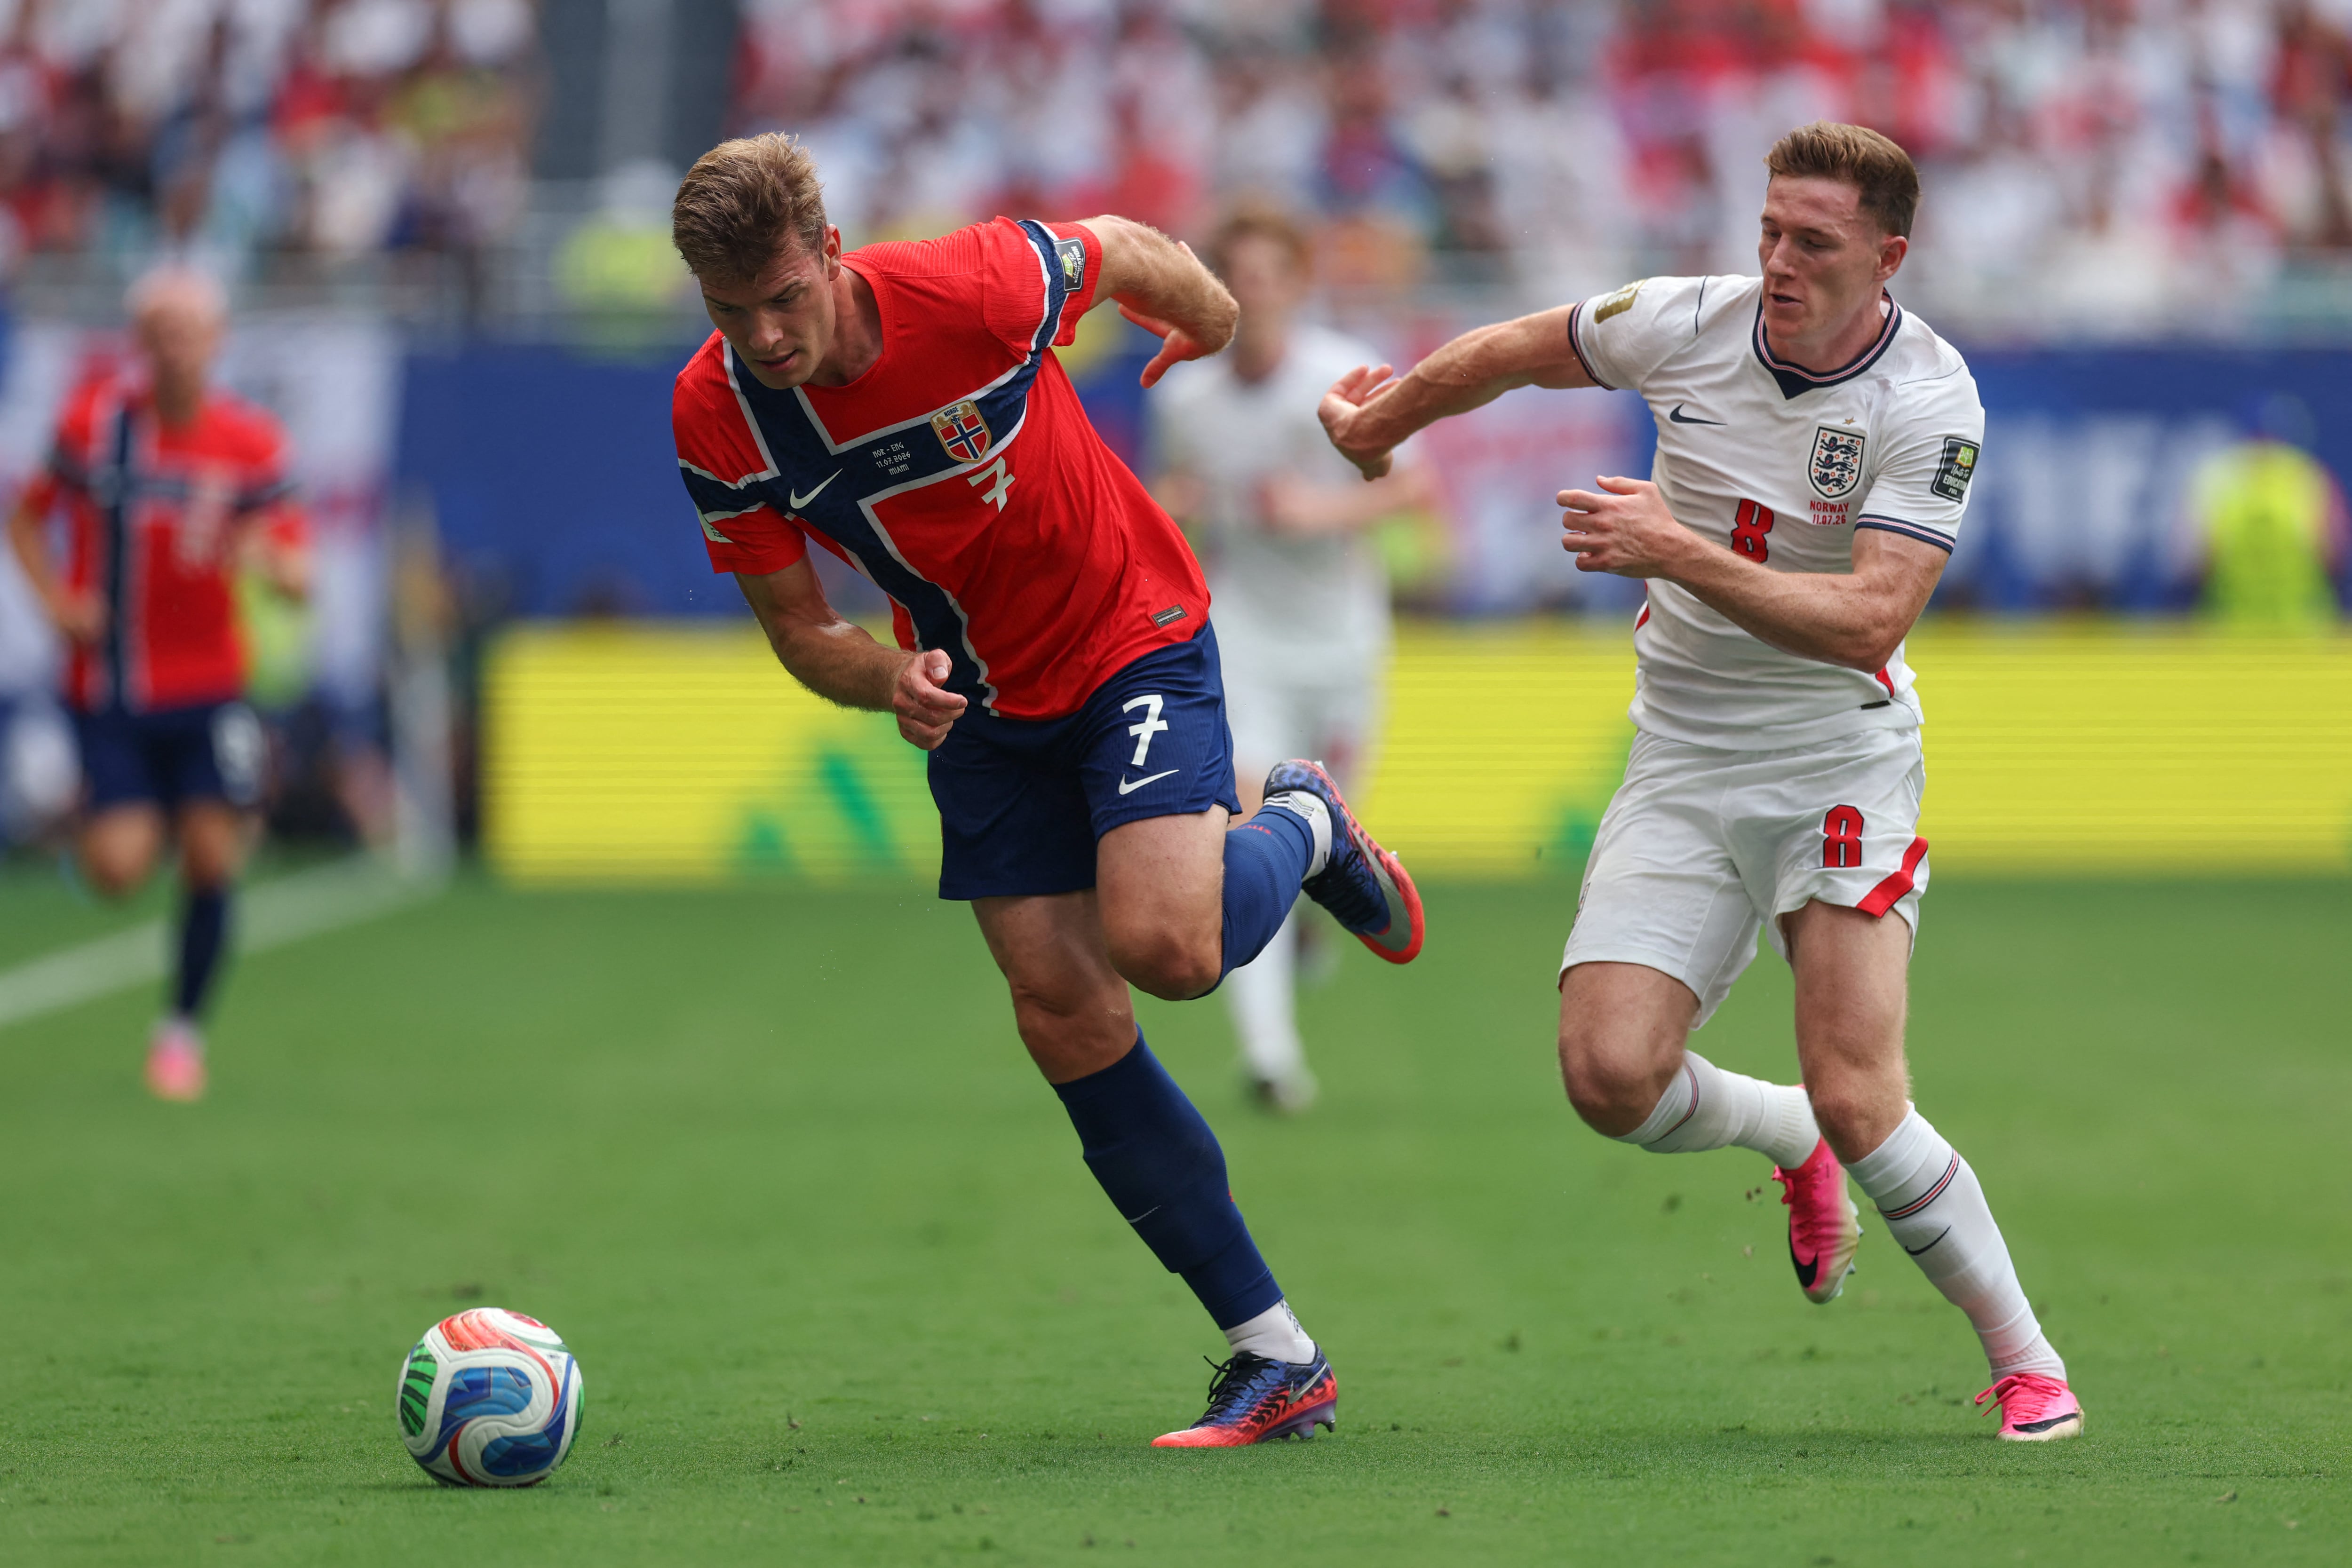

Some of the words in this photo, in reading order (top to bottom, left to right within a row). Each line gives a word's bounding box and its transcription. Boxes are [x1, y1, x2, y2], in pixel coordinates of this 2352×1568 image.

[1071, 246, 1081, 283] EDUCATION
[944, 406, 959, 417] NORGE
[872, 448, 886, 458] NOR
[890, 442, 904, 452] ENG
[876, 451, 911, 468] 11.07.2026
[888, 463, 910, 475] MIAMI
[967, 456, 1015, 513] 7
[1810, 500, 1849, 513] NORWAY
[1813, 514, 1846, 525] 11.07.26
[1731, 499, 1774, 563] 8
[1122, 695, 1168, 766] 7
[1823, 804, 1864, 868] 8
